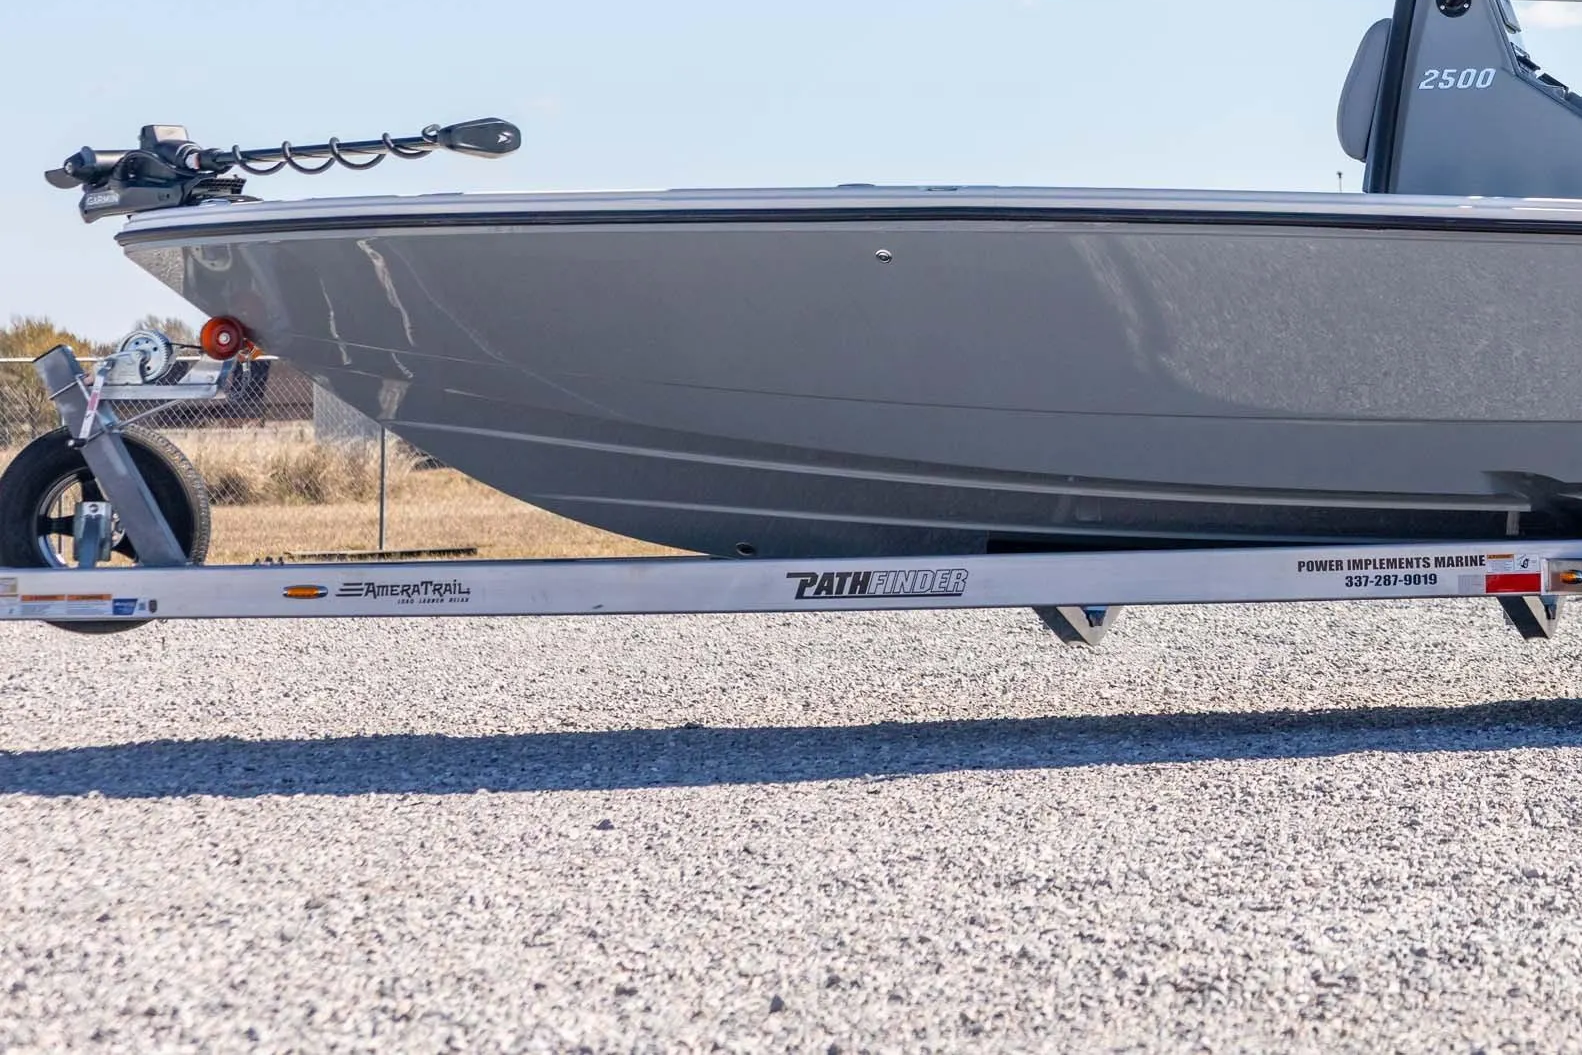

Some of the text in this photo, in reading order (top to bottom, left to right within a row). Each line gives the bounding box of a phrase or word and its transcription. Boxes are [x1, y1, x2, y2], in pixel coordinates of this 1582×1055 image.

[1418, 68, 1497, 90] 2500
[1297, 558, 1344, 573] POWER
[1347, 556, 1431, 572] IMPLEMENTS
[1434, 554, 1487, 569] MARINE
[786, 568, 969, 600] PATHFINDER
[1345, 573, 1438, 588] 337-287-9019
